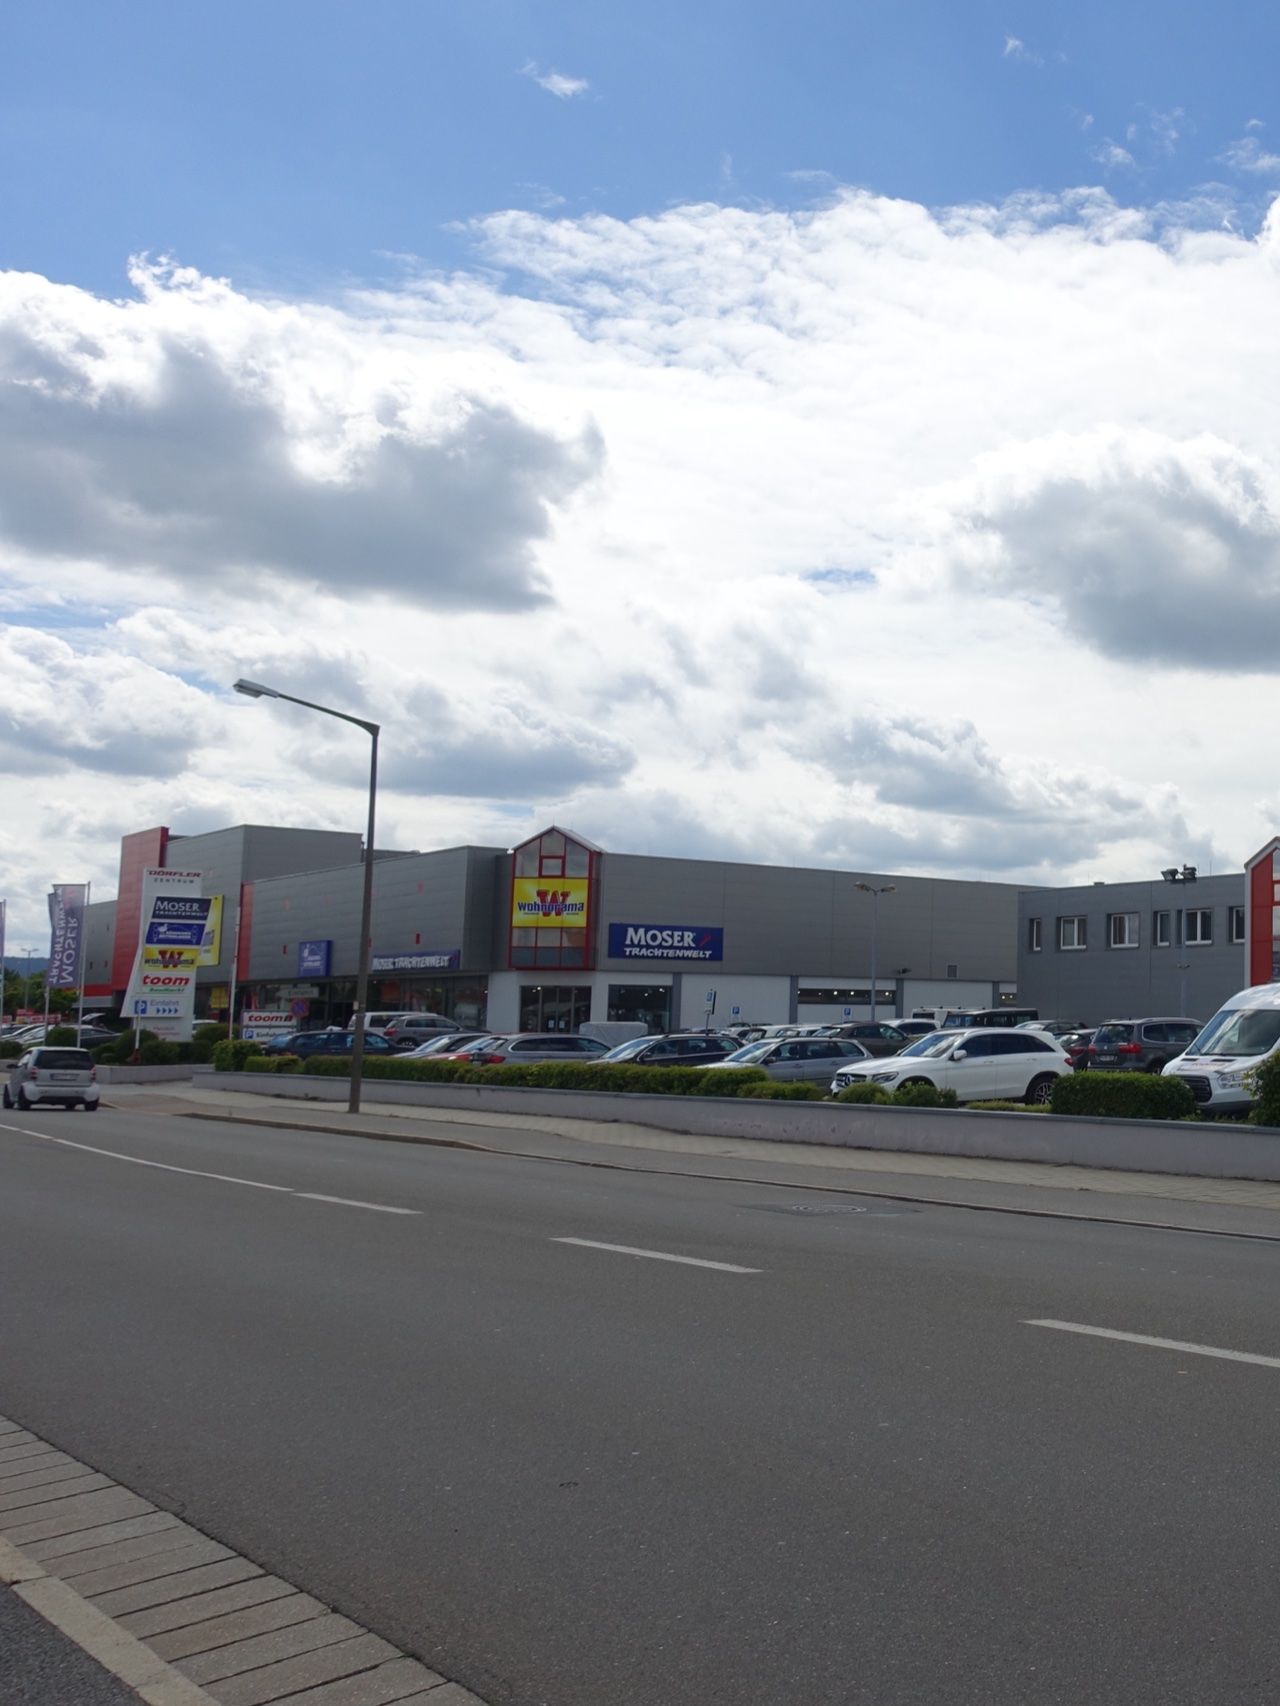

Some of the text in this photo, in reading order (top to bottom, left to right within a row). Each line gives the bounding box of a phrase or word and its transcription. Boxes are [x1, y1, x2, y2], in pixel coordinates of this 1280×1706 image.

[156, 901, 200, 911] MOSER
[518, 901, 584, 912] wohnorama
[625, 927, 696, 947] MOSER
[624, 948, 712, 958] TRACHTENWELT
[143, 974, 190, 985] toom
